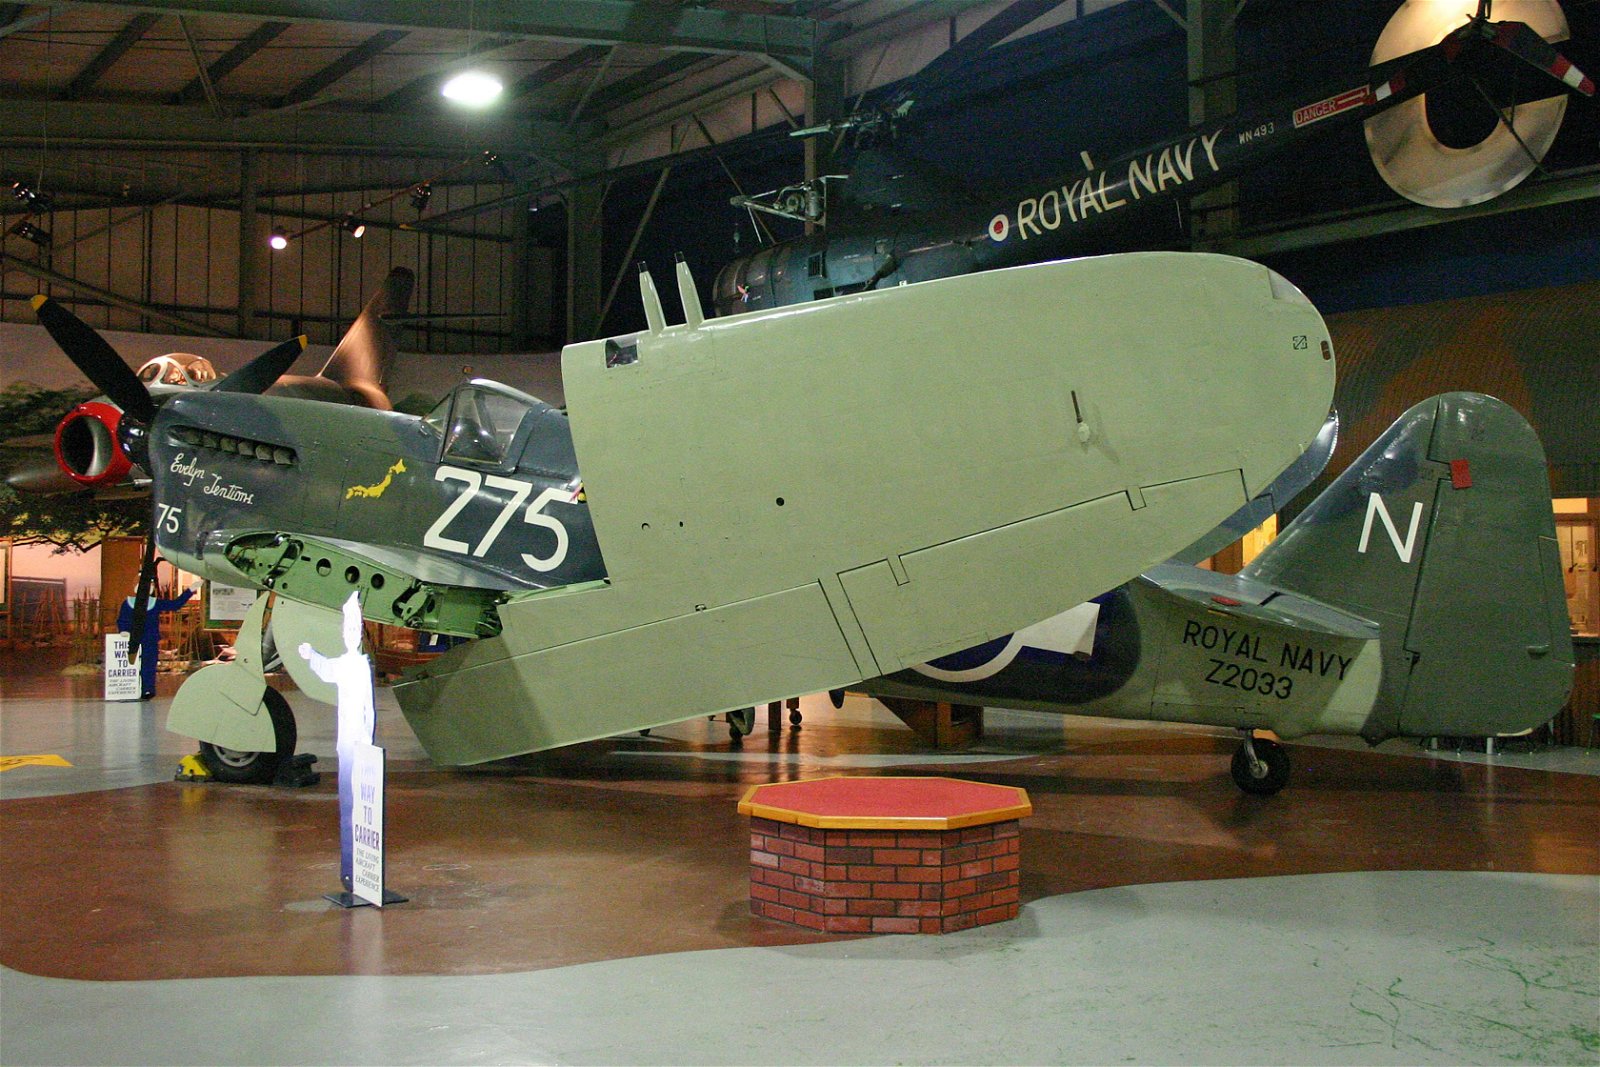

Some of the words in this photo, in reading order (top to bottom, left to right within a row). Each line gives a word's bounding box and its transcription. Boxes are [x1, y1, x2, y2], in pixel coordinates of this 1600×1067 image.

[1295, 99, 1337, 124] DANGER
[1017, 170, 1127, 240] ROYAL
[1128, 128, 1223, 200] NAVY
[170, 452, 205, 487] Evelyn
[156, 502, 182, 534] 75
[423, 465, 578, 573] 275
[1357, 491, 1424, 563] N
[114, 650, 128, 659] WA
[118, 659, 128, 668] TO
[1182, 619, 1268, 663] ROYAL
[1279, 642, 1353, 681] NAVY
[108, 668, 137, 678] CARRIER
[1205, 658, 1293, 700] Z2033
[360, 783, 376, 804] WAY
[363, 805, 373, 825] TO
[354, 824, 380, 851] CARRIER
